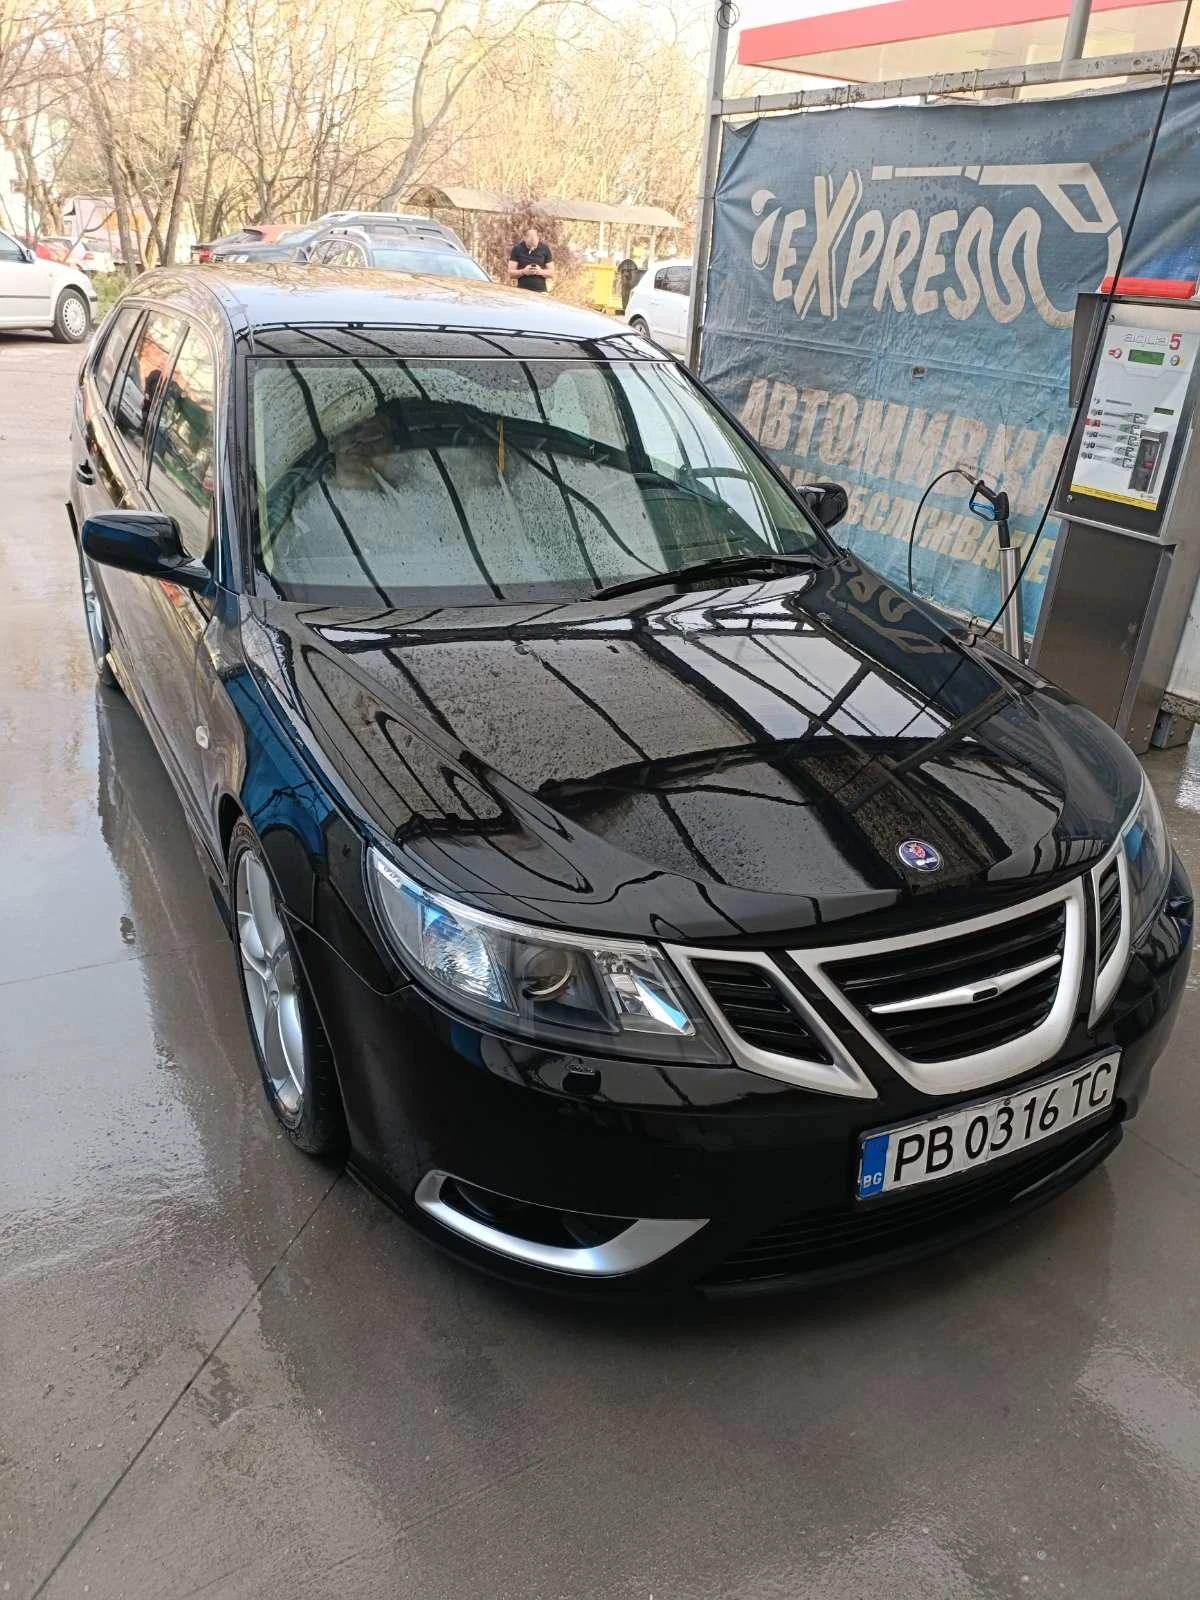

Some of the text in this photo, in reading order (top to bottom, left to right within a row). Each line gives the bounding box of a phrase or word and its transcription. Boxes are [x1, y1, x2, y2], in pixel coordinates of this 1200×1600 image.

[772, 169, 1066, 328] EXPRESS
[741, 377, 1067, 521] АВТОМИВКА
[863, 1172, 882, 1188] BG
[893, 1062, 1111, 1182] PB 0316 TC
